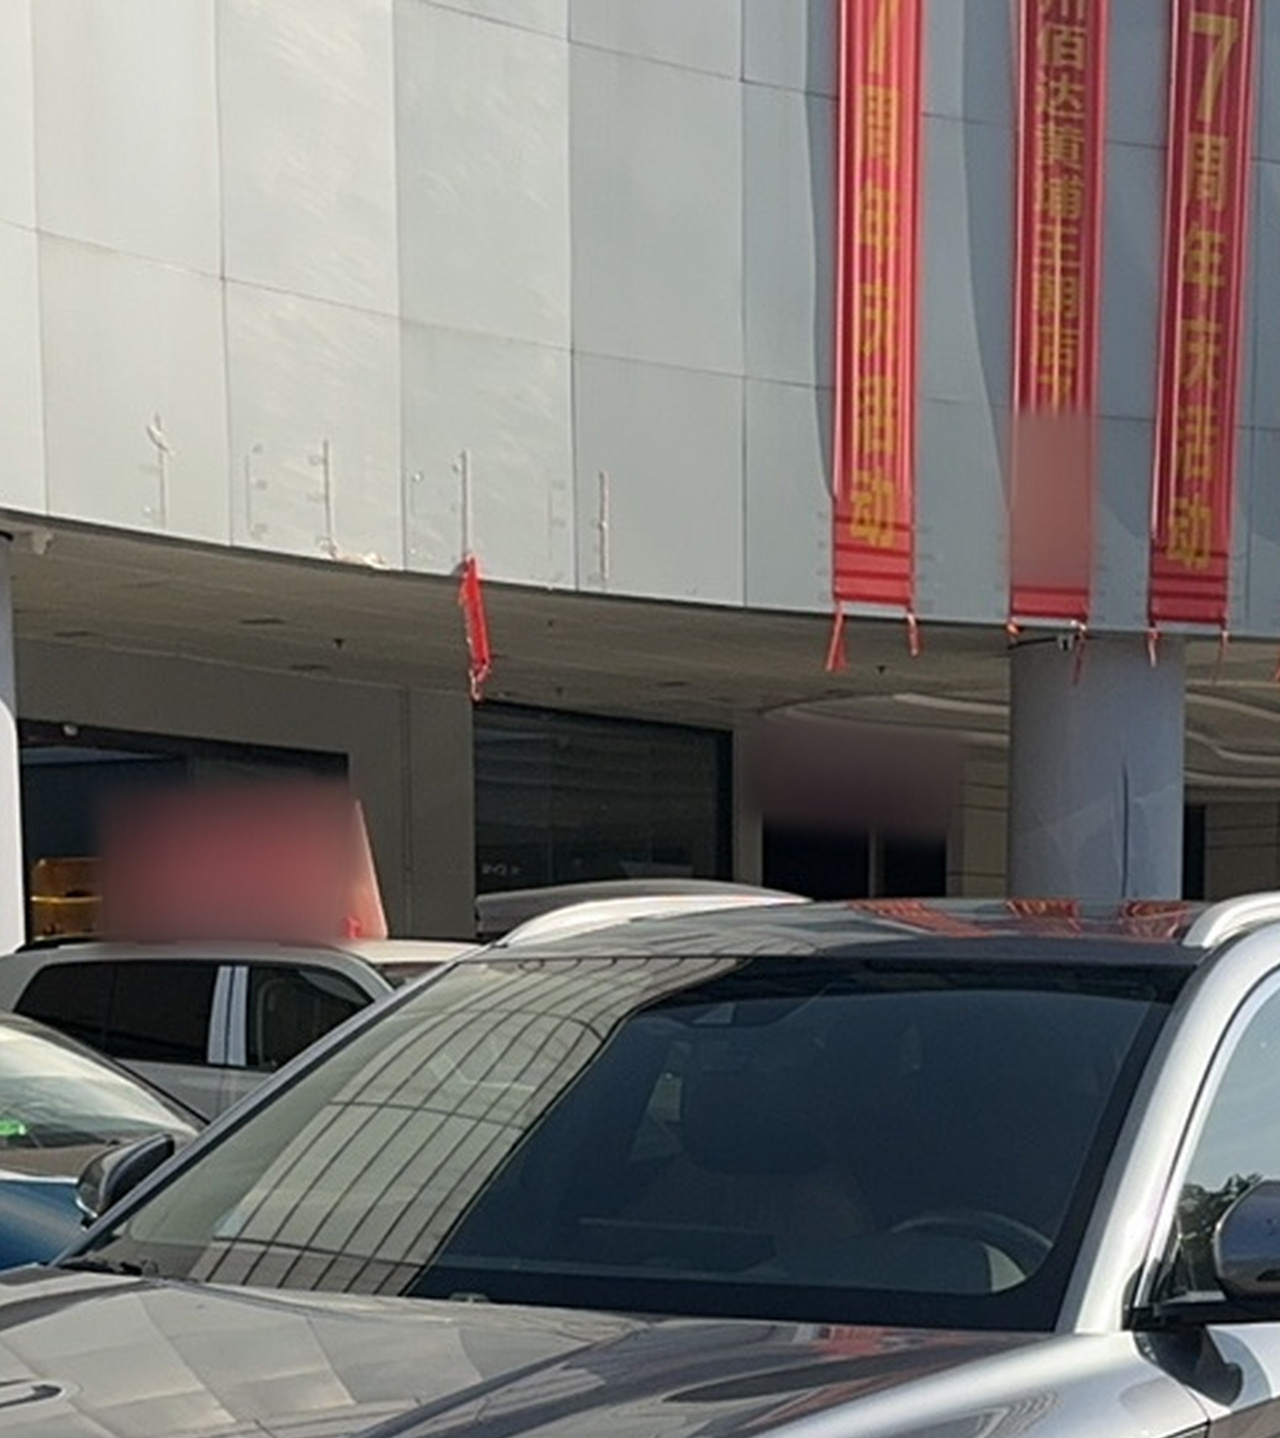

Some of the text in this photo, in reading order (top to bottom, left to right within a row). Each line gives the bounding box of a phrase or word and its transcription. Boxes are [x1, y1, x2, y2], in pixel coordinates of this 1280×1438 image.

[1166, 13, 1238, 571] 7周年庆活动
